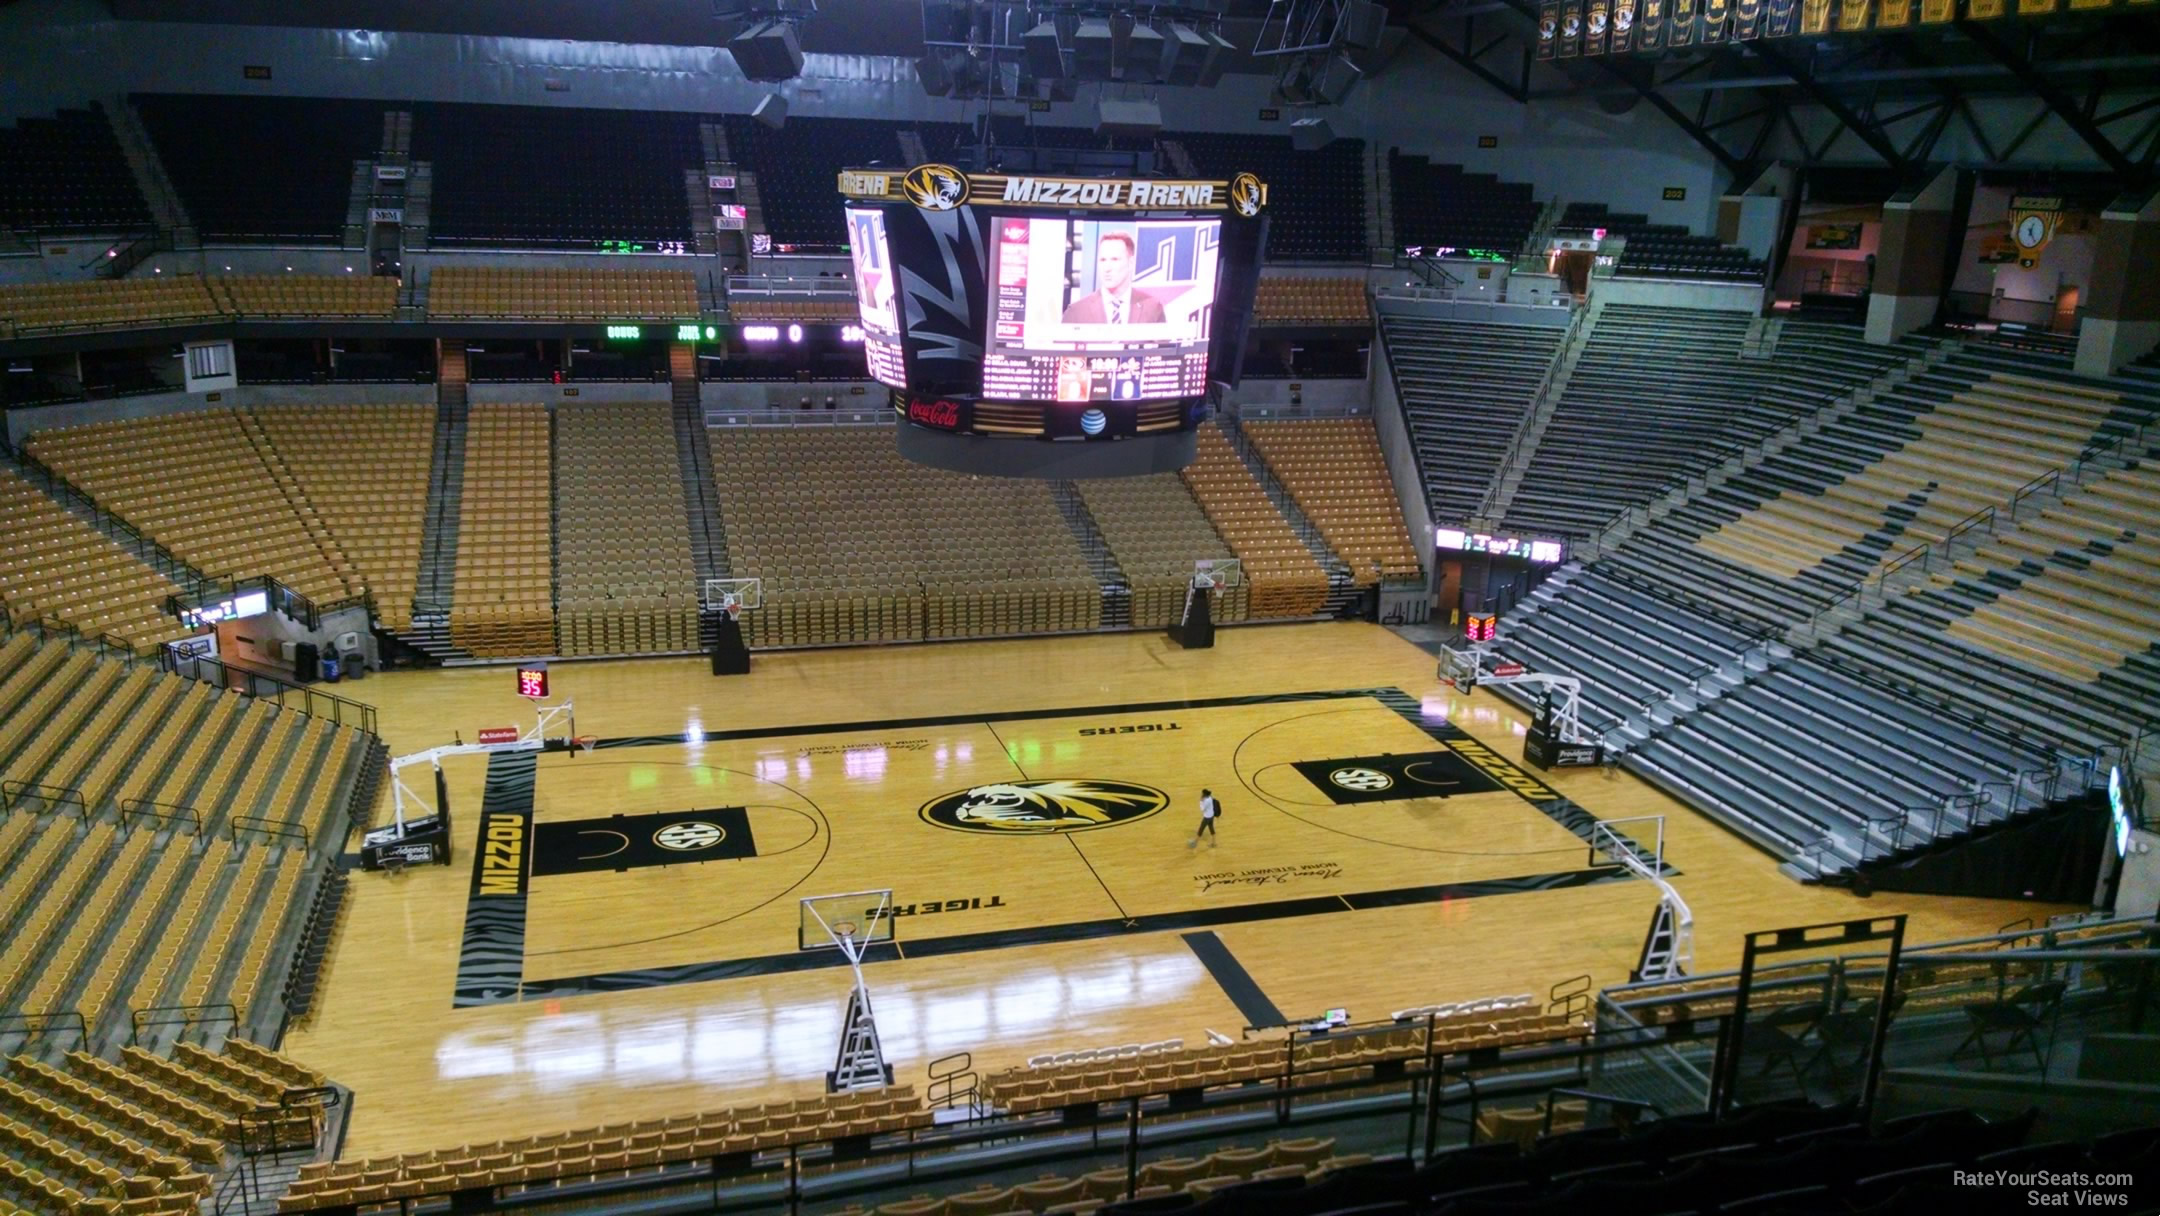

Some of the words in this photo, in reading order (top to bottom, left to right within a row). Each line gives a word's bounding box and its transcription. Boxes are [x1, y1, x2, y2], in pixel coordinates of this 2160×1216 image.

[842, 172, 885, 196] ARENA
[1003, 176, 1122, 206] MIZZOU
[1127, 181, 1214, 207] ARENA
[1664, 189, 1684, 200] 202
[606, 325, 640, 340] BONUS
[522, 680, 541, 695] 35
[1078, 722, 1183, 737] TIGERS
[1445, 738, 1560, 800] MIZZOU
[1334, 768, 1389, 791] SEC
[658, 823, 721, 849] SEC
[406, 851, 430, 862] Bank
[479, 813, 524, 896] MIZZOU
[1240, 866, 1298, 878] STEWART
[1301, 861, 1339, 871] NORM
[1193, 871, 1236, 882] COURT
[864, 895, 1007, 921] TIGERS
